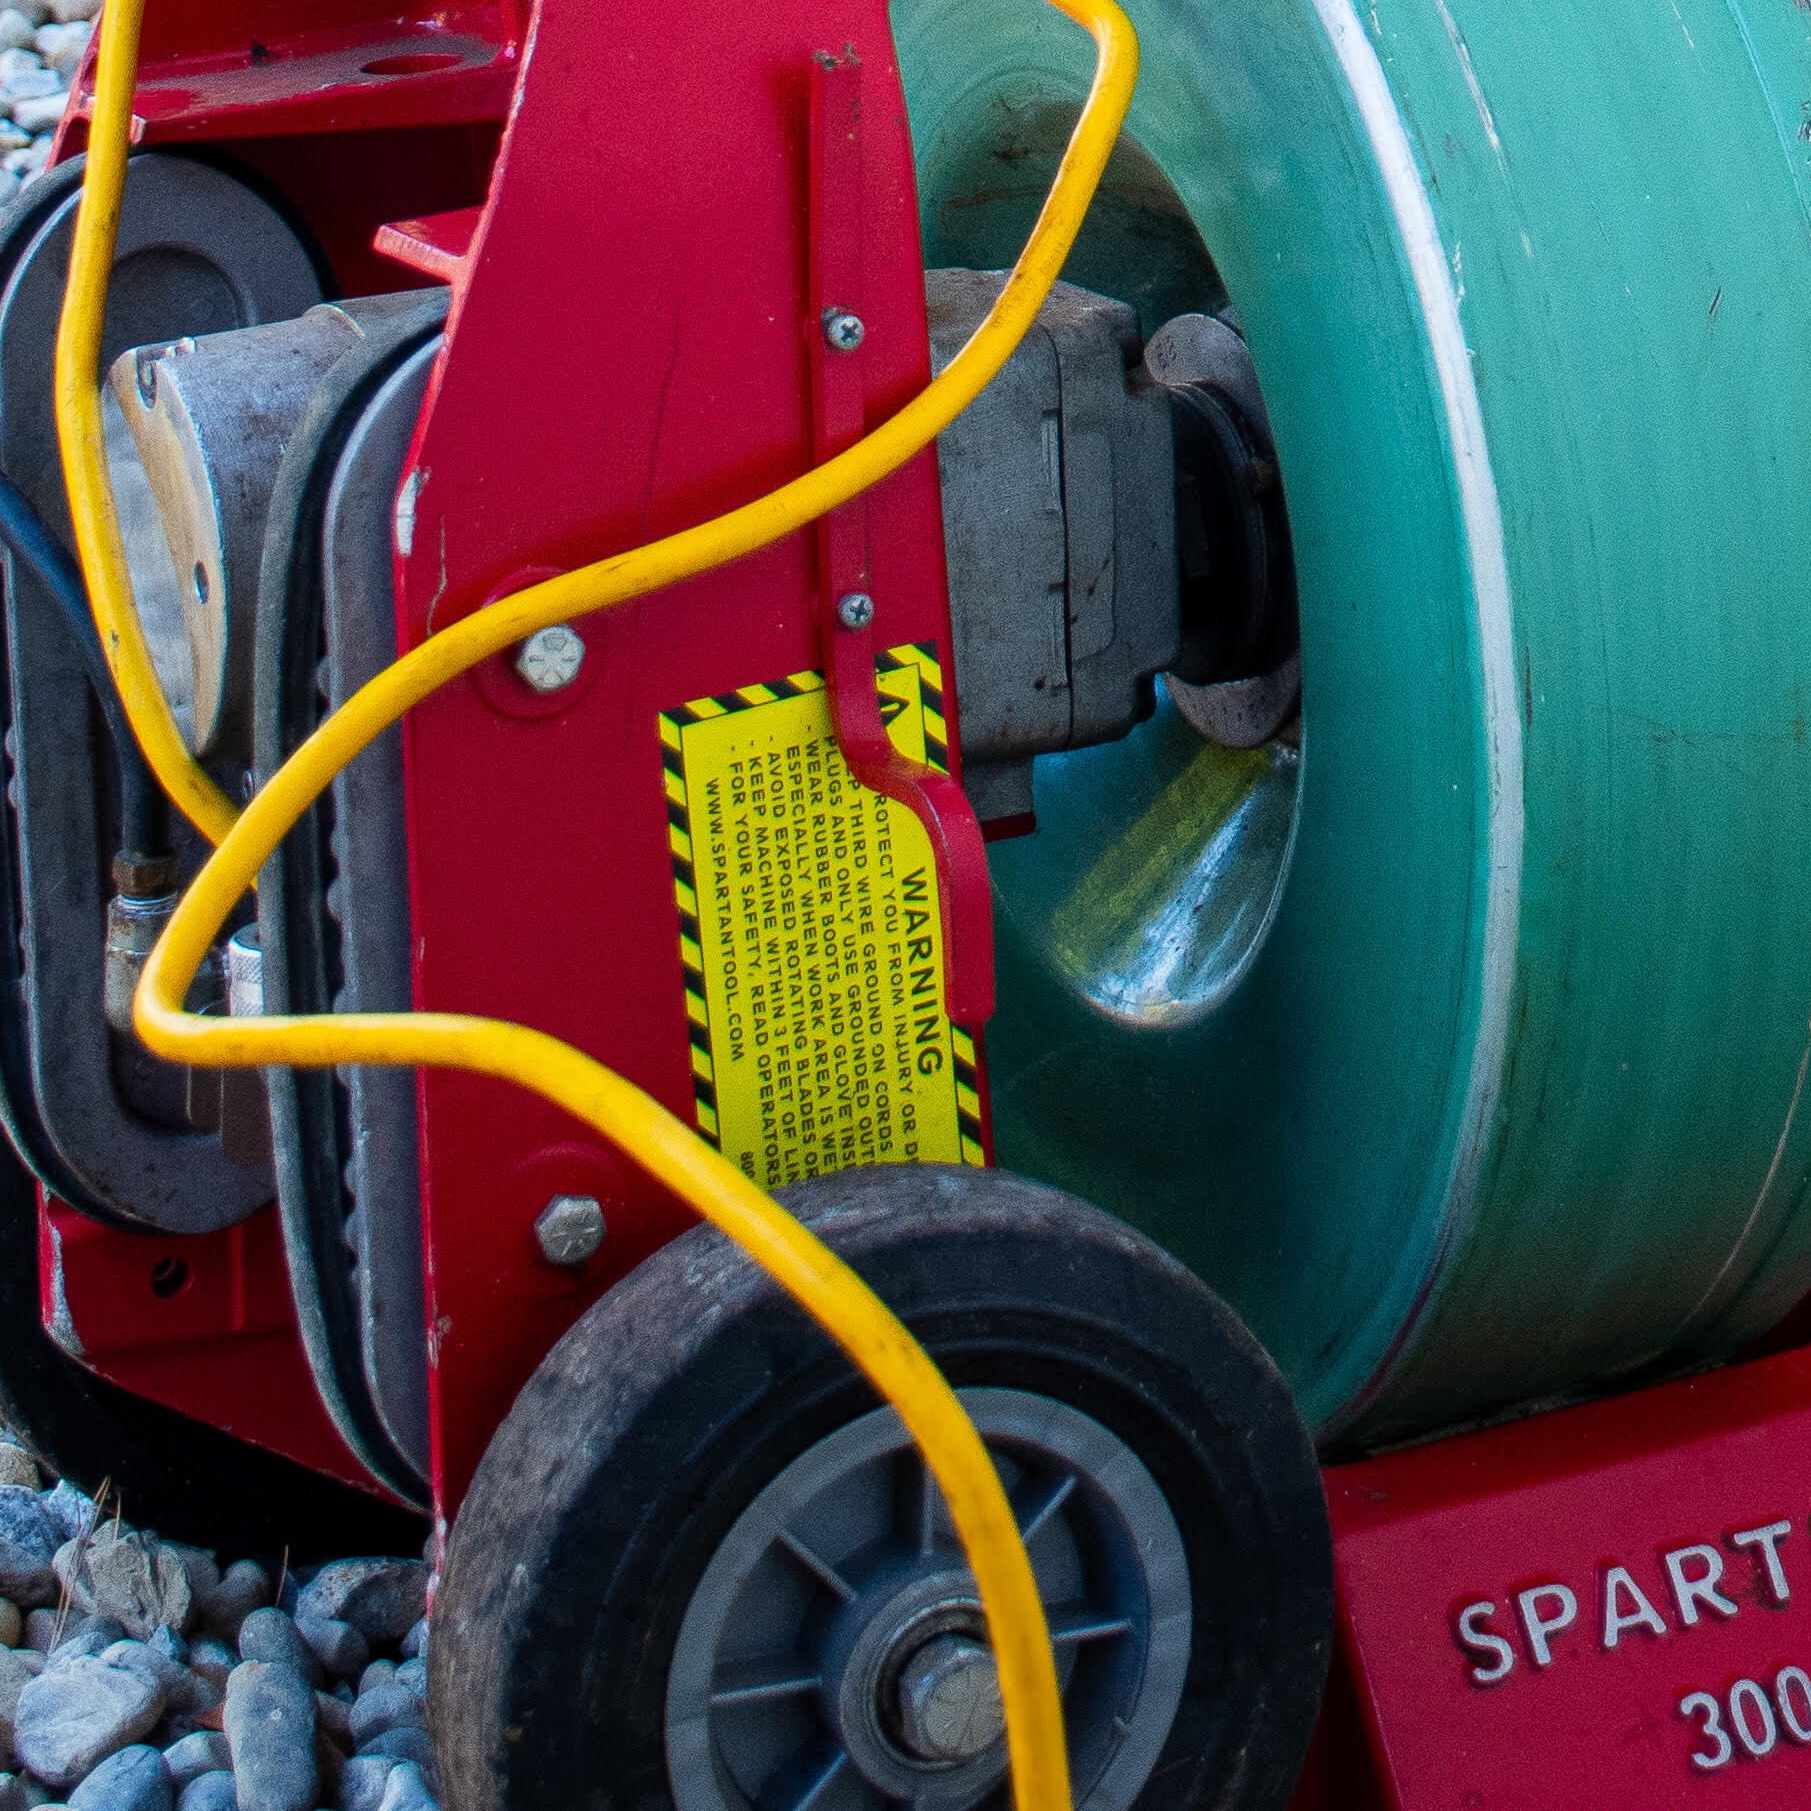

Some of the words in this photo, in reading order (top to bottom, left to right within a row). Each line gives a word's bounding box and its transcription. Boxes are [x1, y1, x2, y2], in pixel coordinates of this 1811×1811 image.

[729, 761, 745, 806] FOR
[748, 756, 766, 818] KEEP
[767, 750, 785, 818] AVOID
[805, 740, 822, 804] WEAR
[824, 735, 841, 806] PLUGS
[734, 814, 752, 876] YOUR
[786, 746, 810, 882] ESPECIALLY
[831, 814, 846, 859] AND
[849, 800, 866, 869] THIRD
[873, 794, 893, 880] ROTECT
[755, 825, 776, 929] MACHINE
[774, 826, 796, 931] EXPOSED
[812, 813, 831, 905] RUBBER
[705, 777, 744, 1061] WWW.SPARTANTOOL.COM
[800, 891, 817, 957] WHEN
[836, 867, 852, 925] ONLY
[856, 876, 872, 934] WIRE
[882, 889, 898, 933] YOU
[765, 937, 784, 1019] WITHIN
[821, 915, 838, 983] BOOTS
[842, 934, 857, 975] USE
[887, 943, 904, 1005] FROM
[900, 867, 943, 1077] WARNING
[750, 985, 768, 1048] READ
[785, 939, 807, 1050] ROTATING
[806, 964, 824, 1029] WORK
[828, 991, 843, 1036] AND
[862, 942, 882, 1035] GROUND
[773, 1026, 786, 1037] 3
[847, 984, 870, 1108] GROUNDED
[871, 1043, 885, 1073] ON
[894, 1014, 913, 1095] INJURY
[775, 1044, 792, 1104] FEET
[813, 1037, 830, 1098] AREA
[833, 1044, 851, 1119] GLOVE
[781, 1111, 796, 1140] OF
[796, 1058, 815, 1143] BLADES
[820, 1106, 832, 1125] IS
[875, 1080, 892, 1152] CORDS
[902, 1103, 916, 1133] OR
